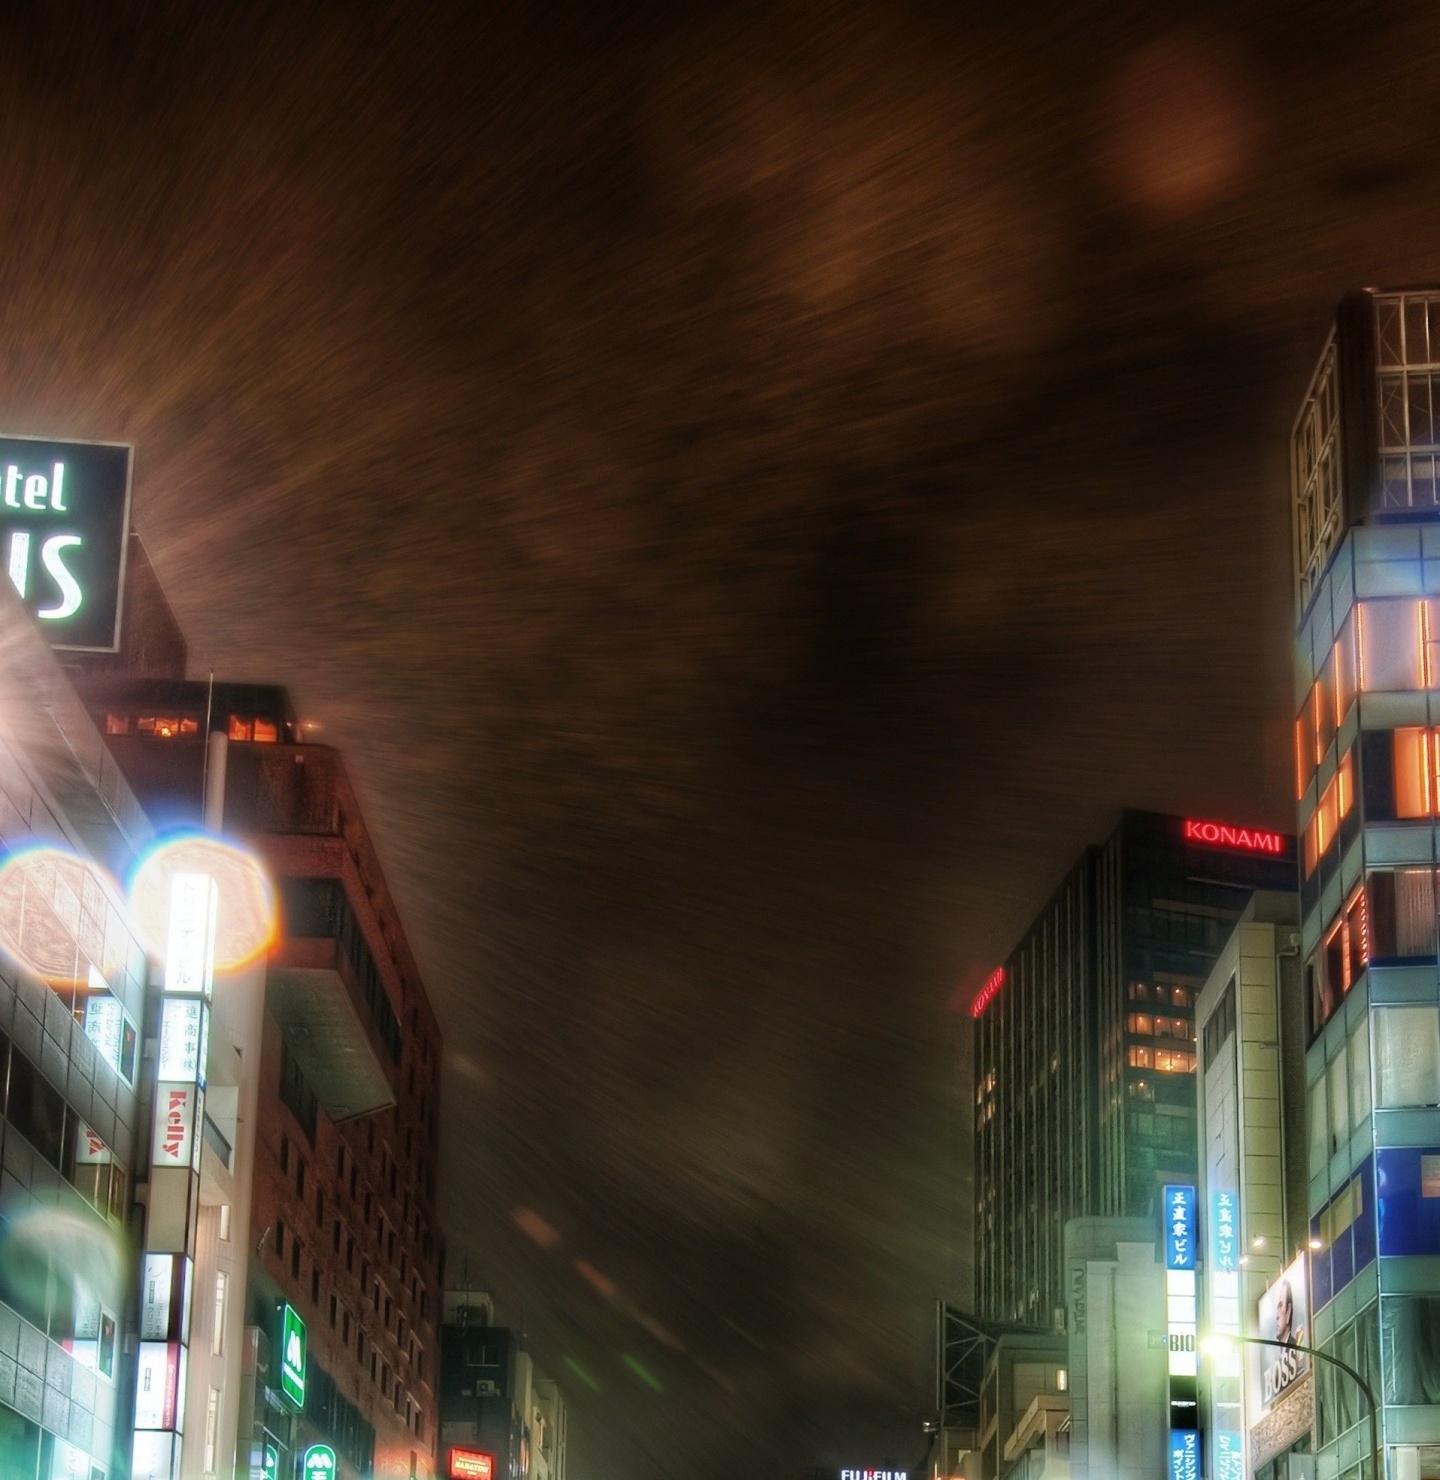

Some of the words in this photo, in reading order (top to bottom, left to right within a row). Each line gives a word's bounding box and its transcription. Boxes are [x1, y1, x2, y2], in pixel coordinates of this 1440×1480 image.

[0, 463, 67, 511] tel
[1187, 821, 1280, 851] KONAMI
[162, 1091, 187, 1158] Kelly
[1172, 1192, 1188, 1265] 正直家ビル
[1264, 1347, 1297, 1402] BOSS
[1173, 1450, 1184, 1480] ポイント
[1184, 1434, 1197, 1480] ヴァニシング
